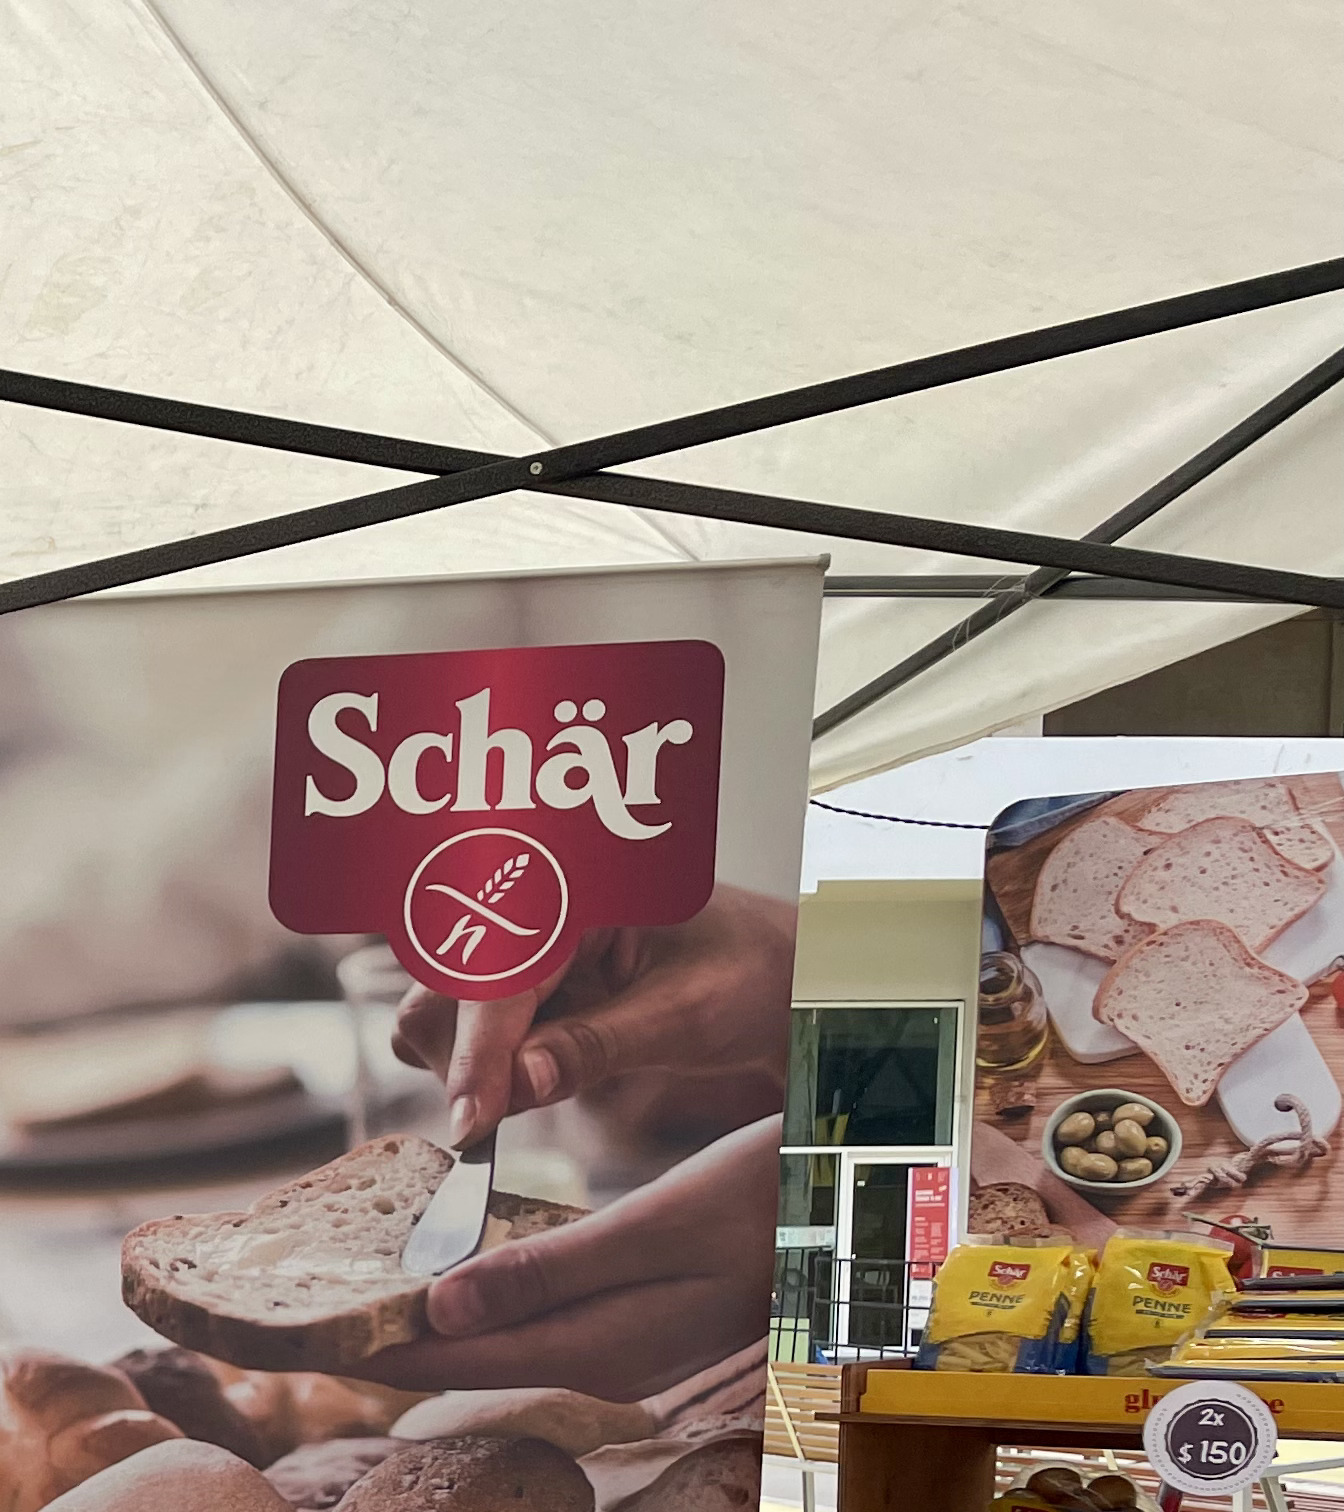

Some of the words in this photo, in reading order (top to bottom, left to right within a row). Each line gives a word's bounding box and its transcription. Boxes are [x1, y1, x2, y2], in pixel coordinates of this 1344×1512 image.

[305, 687, 693, 840] Schär
[968, 1290, 1026, 1304] PENNE
[1132, 1295, 1193, 1314] PENNE
[1198, 1408, 1225, 1426] 2x
[1177, 1442, 1193, 1464] $
[1200, 1440, 1247, 1465] 150
